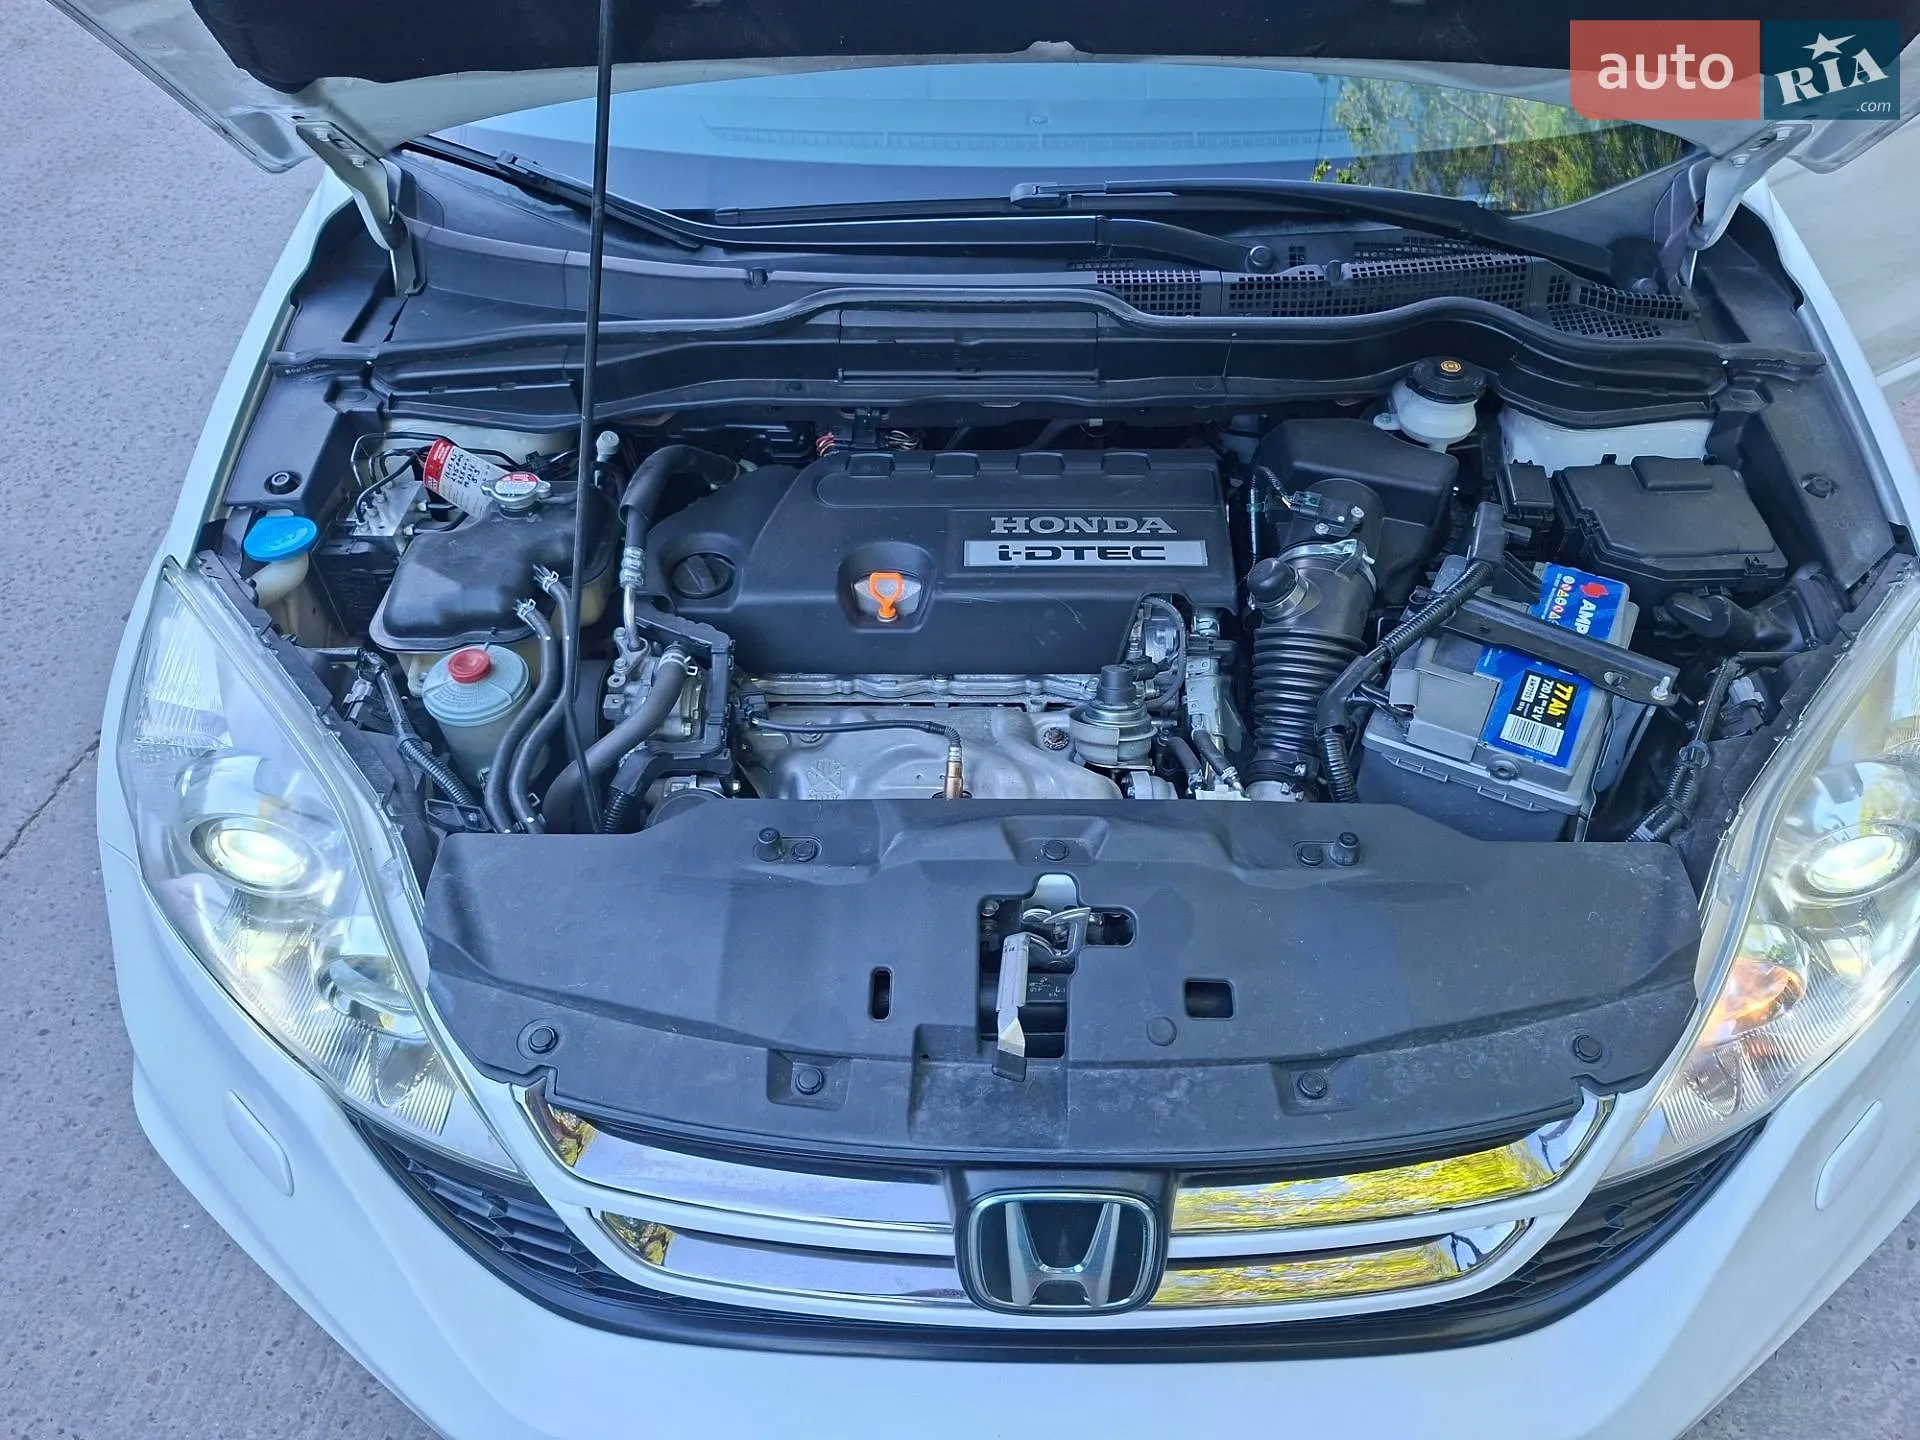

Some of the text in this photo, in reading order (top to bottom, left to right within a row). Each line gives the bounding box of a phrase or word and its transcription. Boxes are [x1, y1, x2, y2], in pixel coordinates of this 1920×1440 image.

[991, 516, 1177, 534] HONDA
[998, 544, 1166, 561] i-DTEC
[1541, 679, 1555, 694] 720
